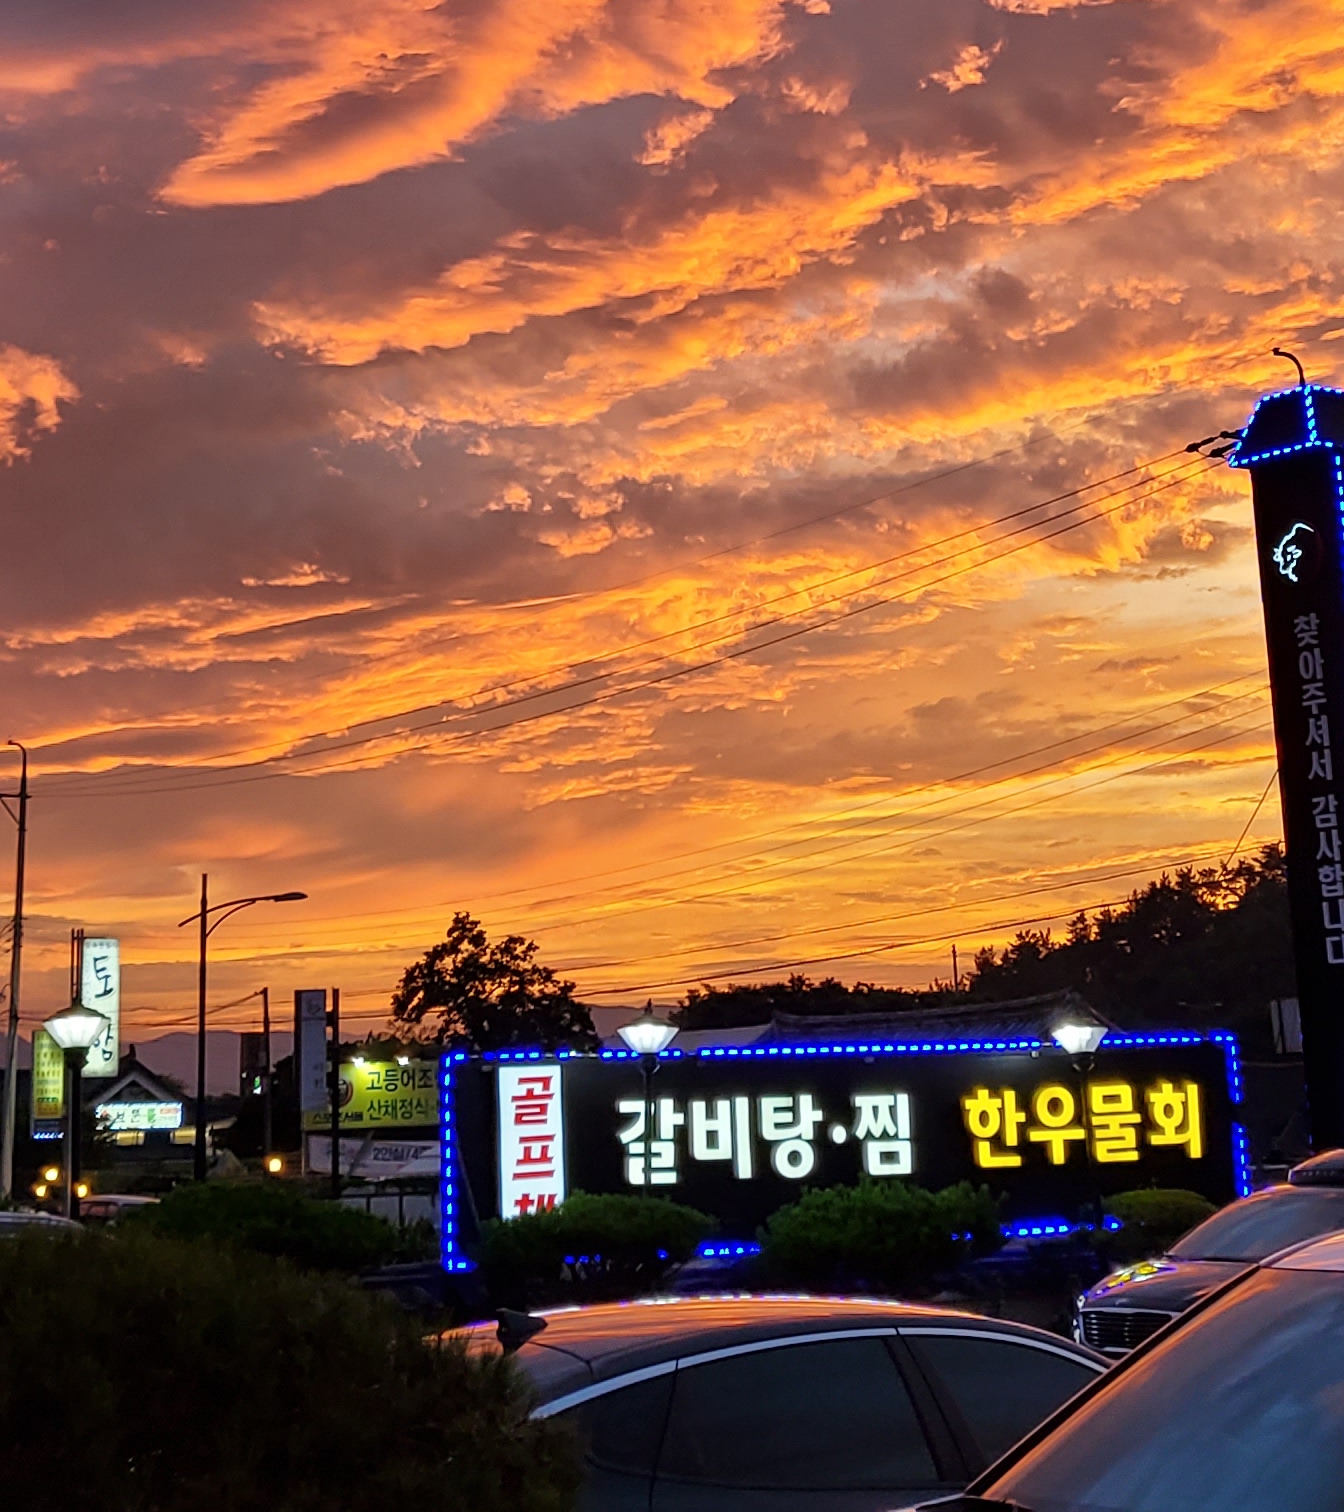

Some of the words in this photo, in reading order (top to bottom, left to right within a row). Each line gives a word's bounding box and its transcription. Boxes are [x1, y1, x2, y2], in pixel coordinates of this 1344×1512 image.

[1293, 612, 1334, 781] 찾아주셔서
[365, 1068, 439, 1092] 고등어조
[963, 1082, 1203, 1168] 한우물회
